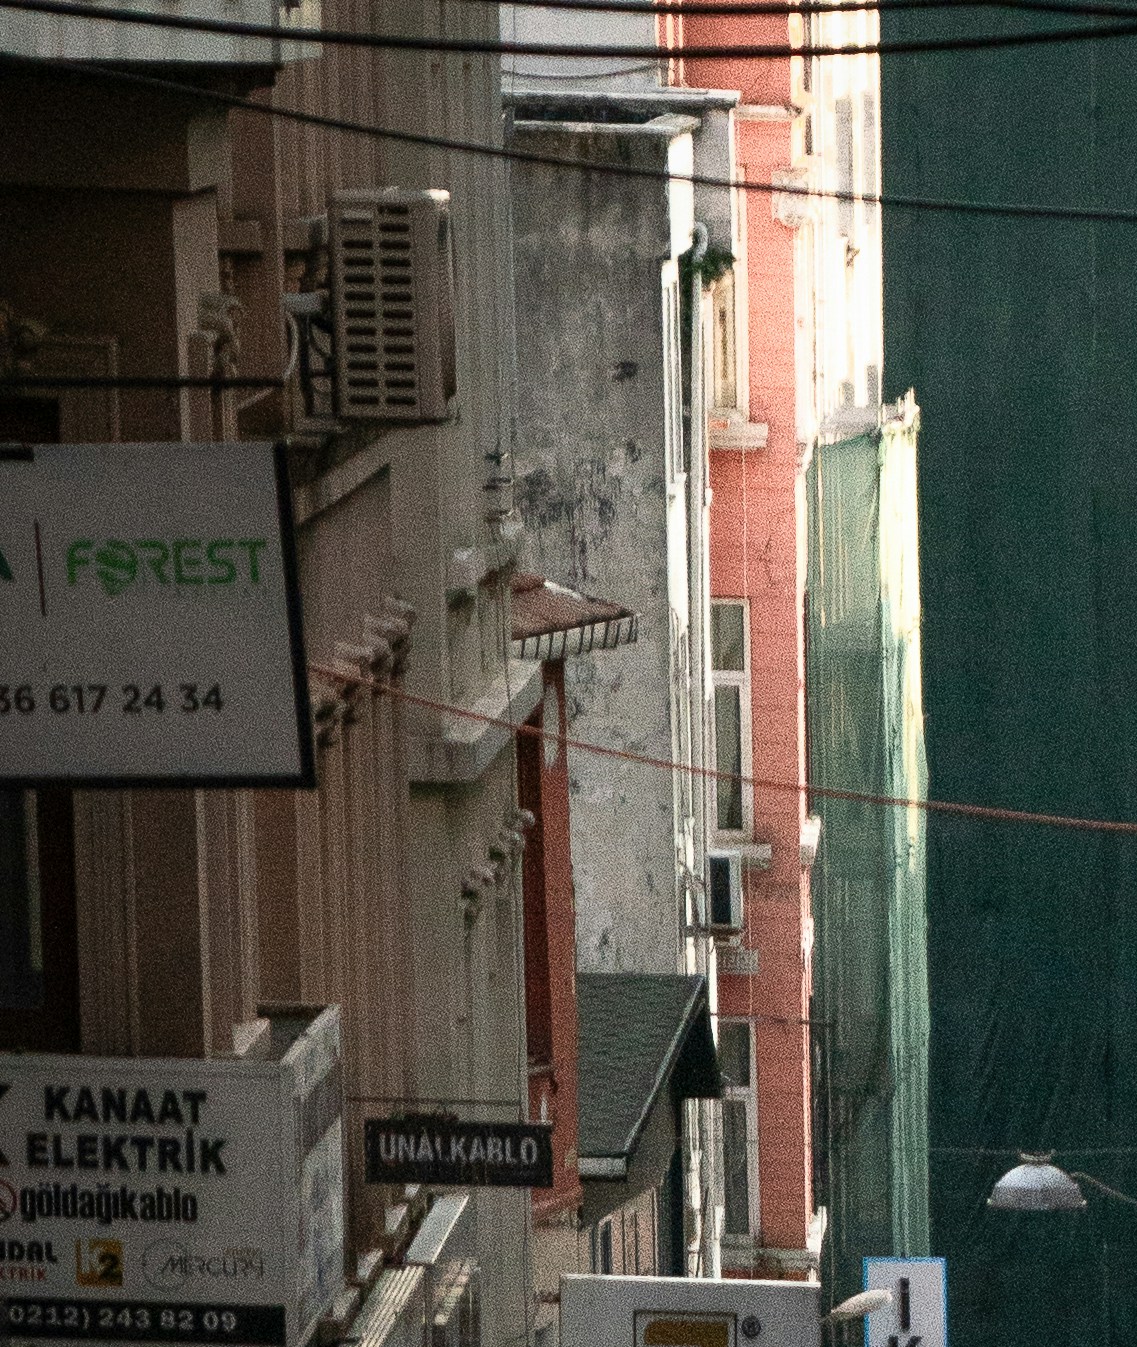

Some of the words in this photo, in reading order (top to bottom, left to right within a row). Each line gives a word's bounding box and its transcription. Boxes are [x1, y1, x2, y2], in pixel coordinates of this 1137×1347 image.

[65, 537, 267, 597] FOREST
[49, 684, 106, 715] 617
[122, 685, 166, 715] 24
[180, 684, 225, 715] 34
[45, 1086, 206, 1124] KANAAT
[26, 1128, 226, 1174] ELEKTRİK
[98, 1306, 151, 1331] 243
[160, 1308, 195, 1331] 82
[202, 1309, 238, 1332] 09
